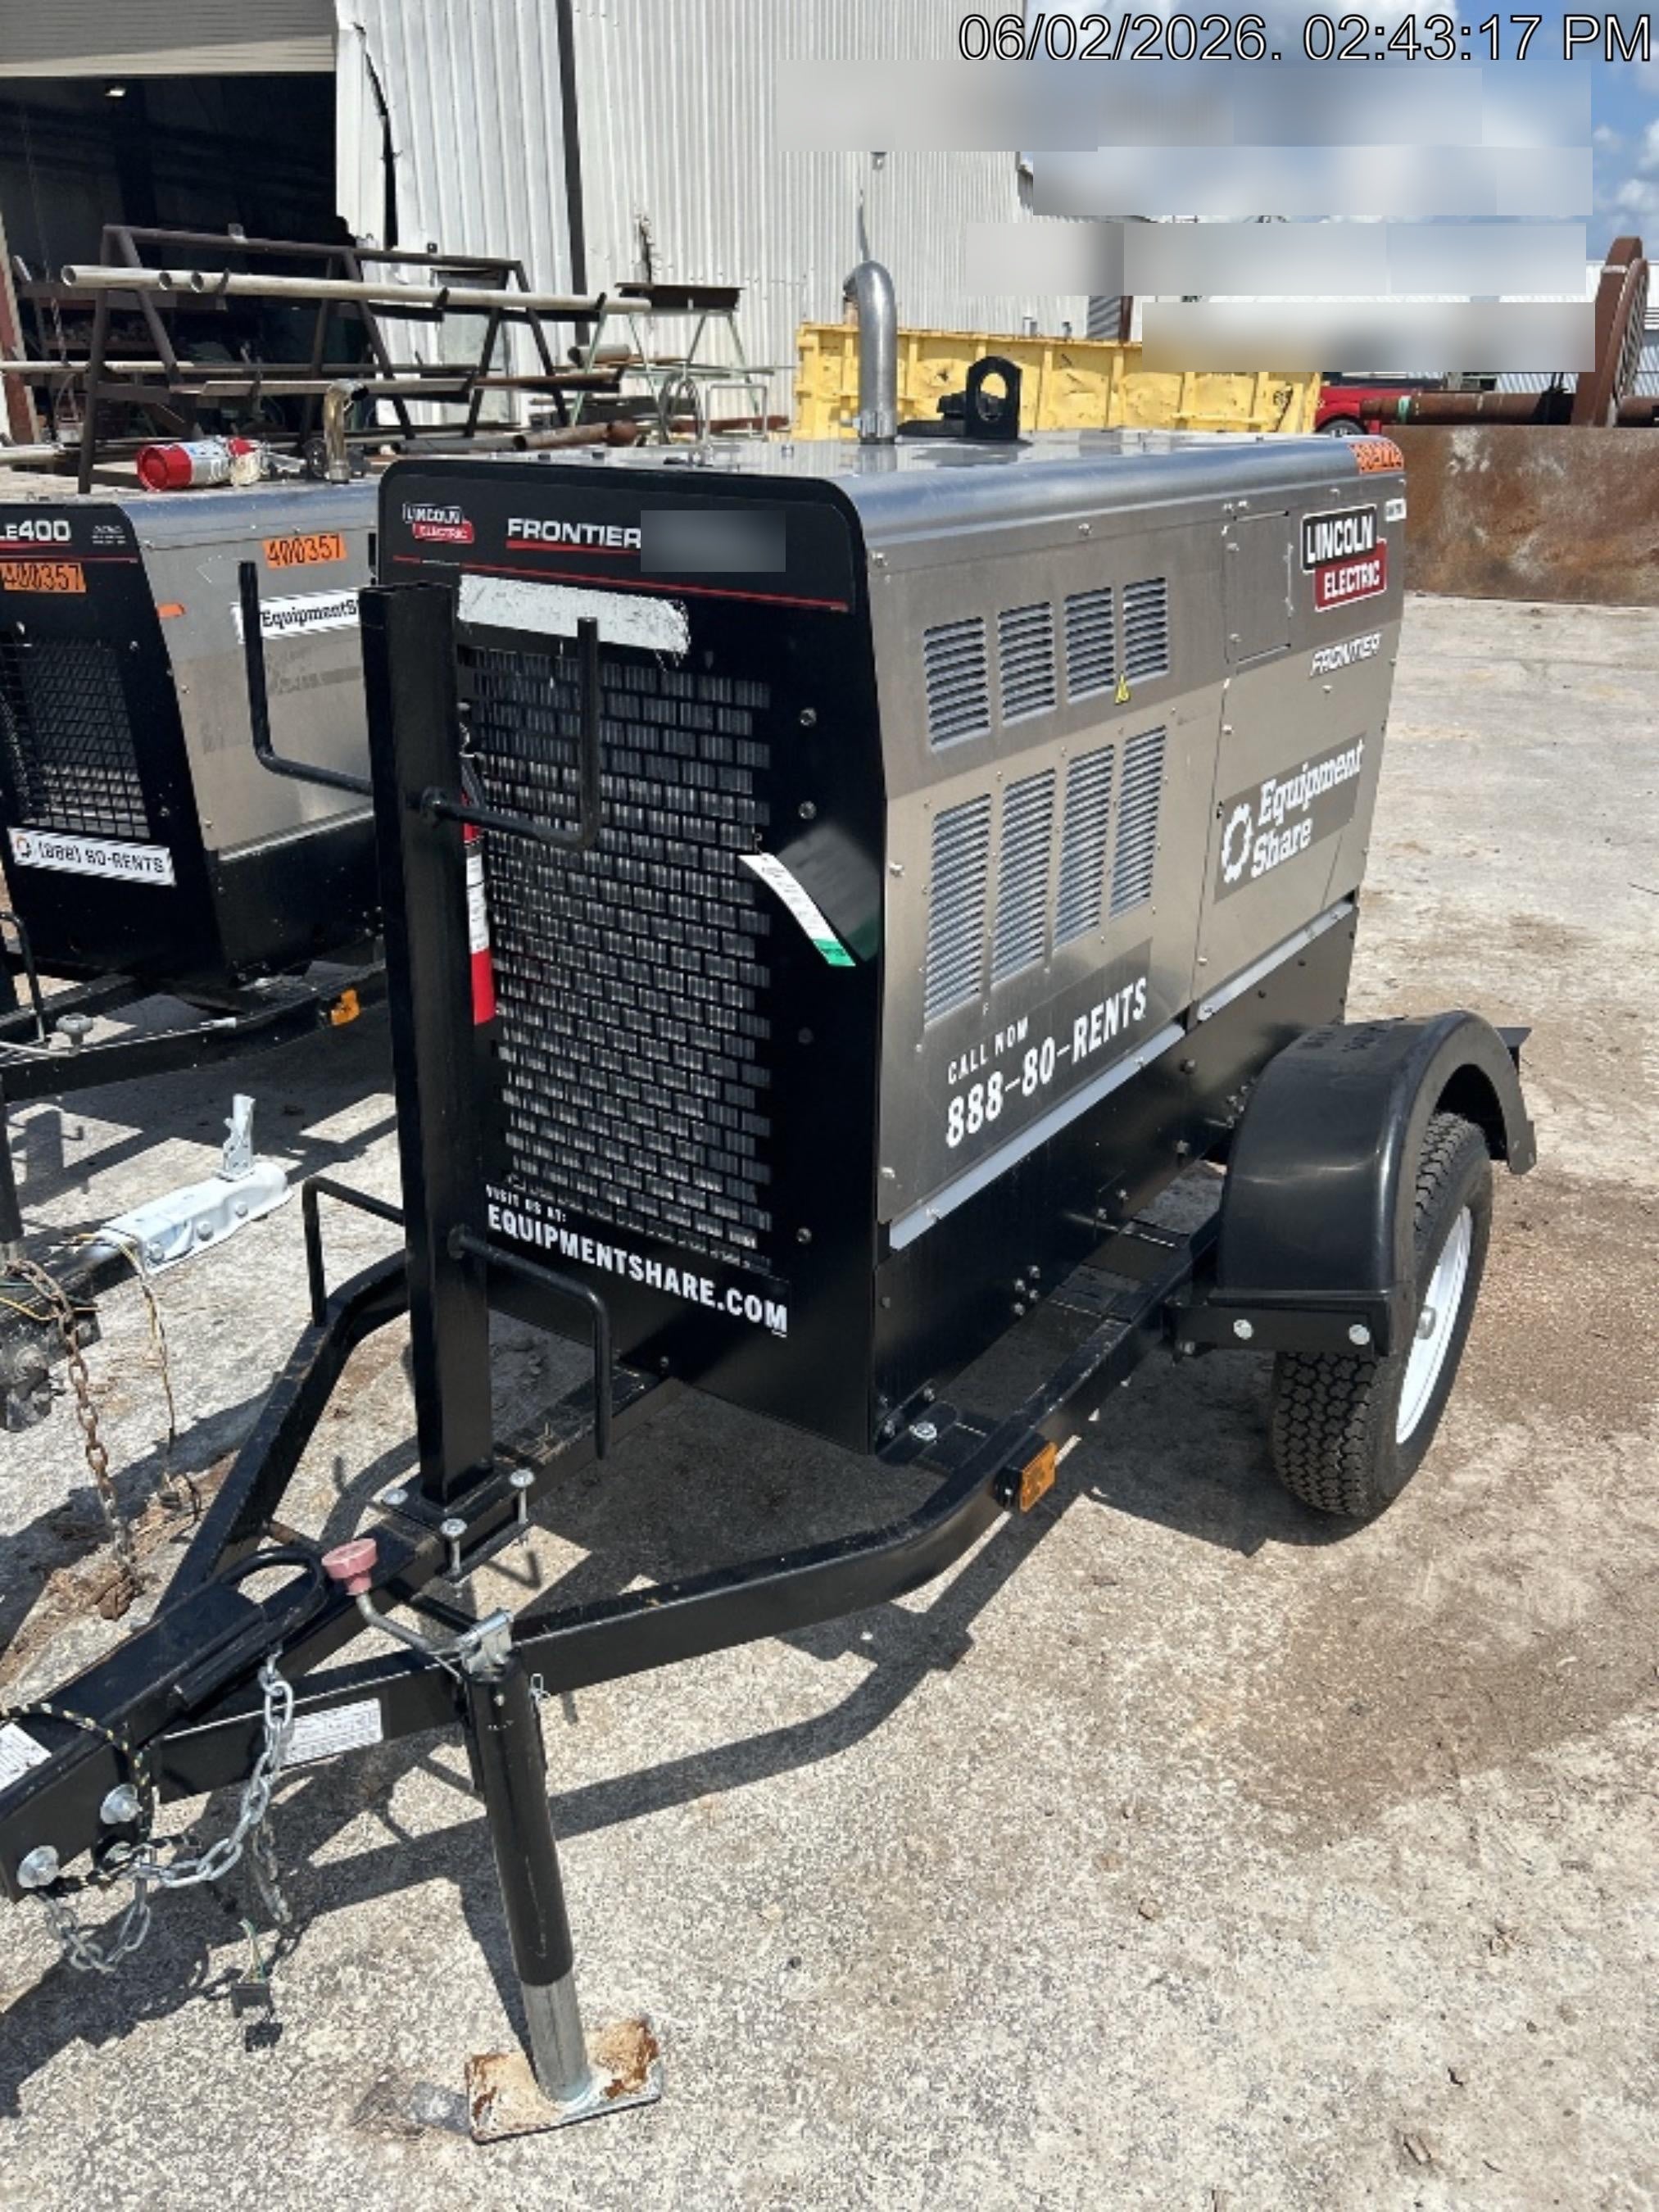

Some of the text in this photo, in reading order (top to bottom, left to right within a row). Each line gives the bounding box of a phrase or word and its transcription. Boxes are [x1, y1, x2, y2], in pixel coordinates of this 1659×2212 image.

[407, 506, 460, 524] LINCOLN
[507, 518, 641, 549] FRONTIER
[1307, 514, 1374, 564] LINCOLN
[1324, 560, 1380, 601] ELECTRIC
[261, 599, 359, 629] EquipmentS
[1311, 633, 1382, 677] FRONTIER
[1258, 738, 1365, 826] Equipment
[1251, 818, 1312, 878] Share
[946, 977, 1147, 1148] 888-80-RENTS
[948, 1015, 1028, 1085] CALL NOW
[487, 1203, 787, 1334] EQUIPMENTSHARE.COM
